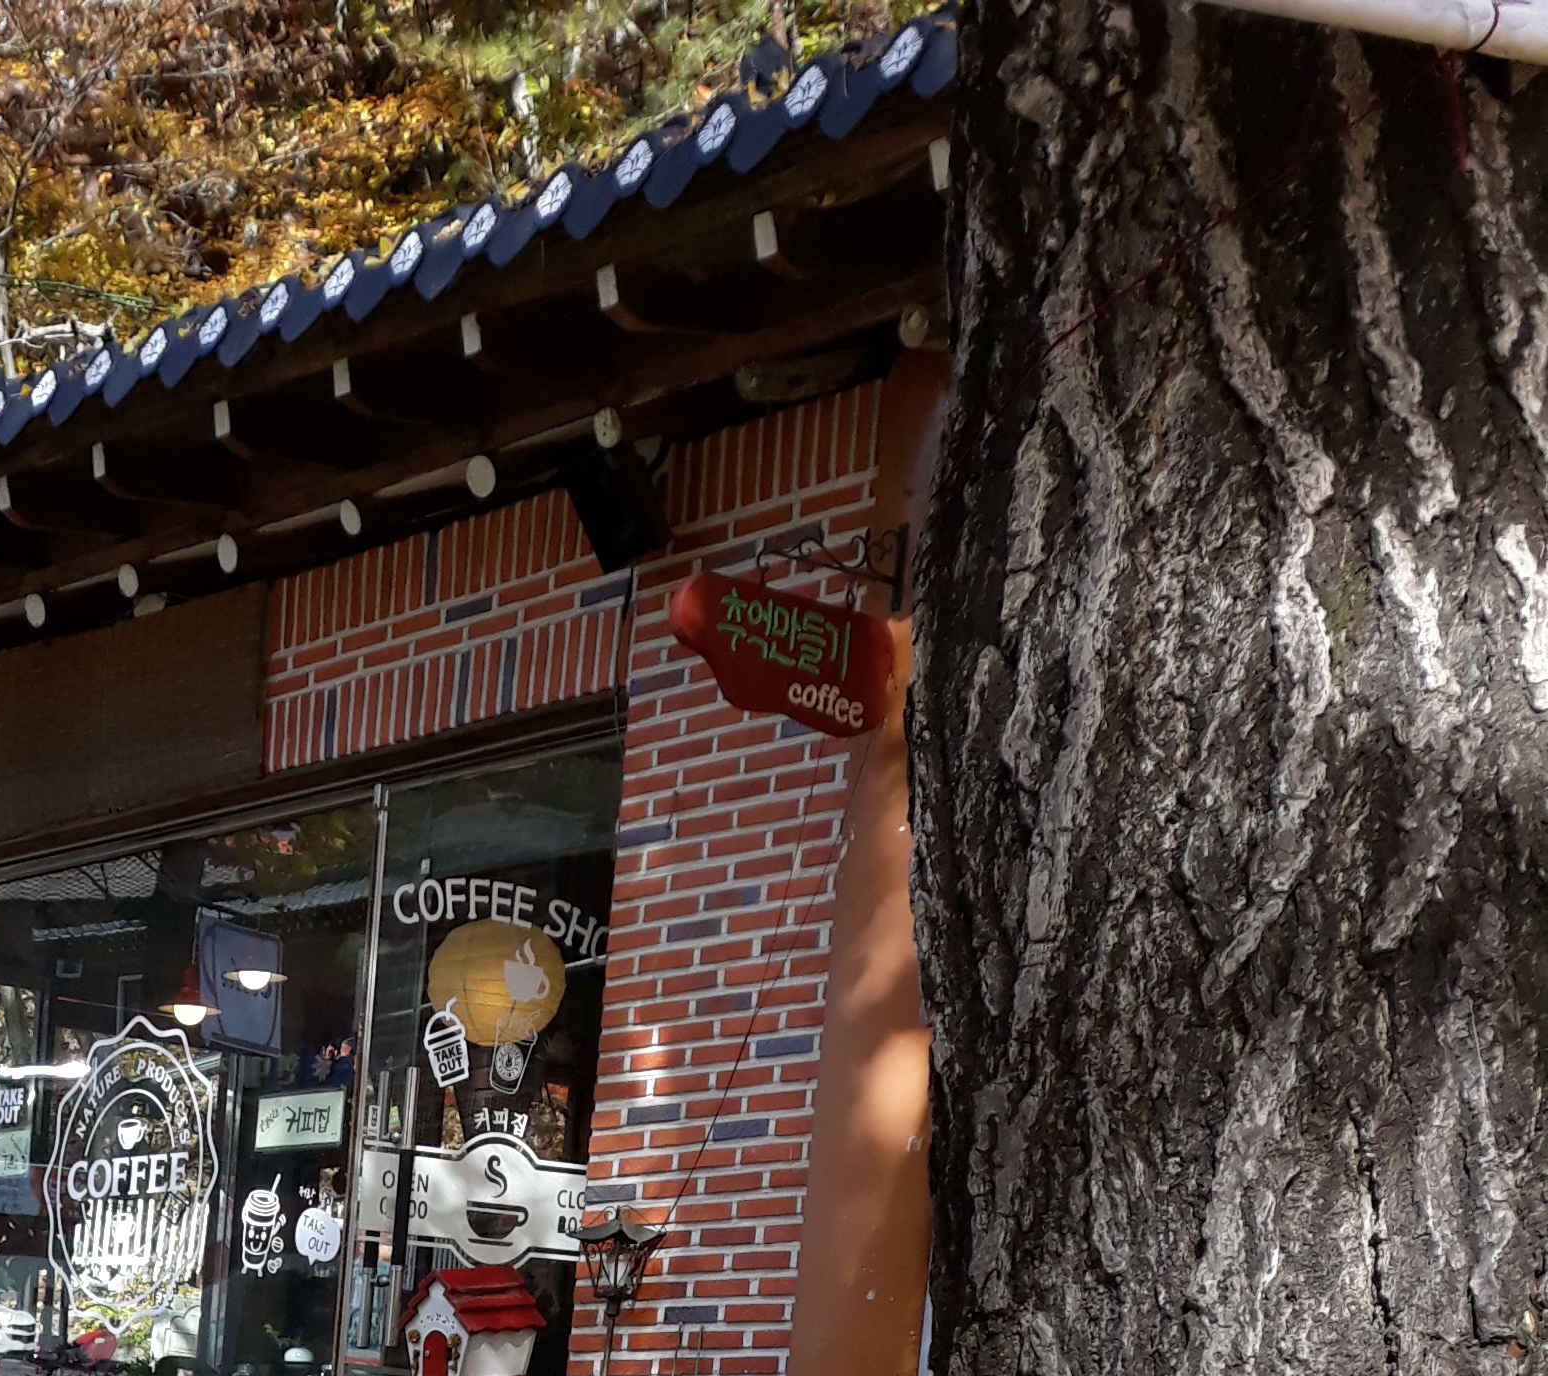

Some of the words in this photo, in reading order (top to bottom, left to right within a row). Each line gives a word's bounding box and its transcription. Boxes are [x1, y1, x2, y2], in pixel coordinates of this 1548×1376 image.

[788, 682, 864, 729] coffee
[393, 877, 537, 930] COFFEE
[543, 899, 610, 965] SHO
[434, 1044, 463, 1063] TAKE
[438, 1056, 462, 1075] OUT
[75, 1064, 122, 1140] NATURE
[136, 1057, 191, 1145] PRODUCTS
[473, 1107, 529, 1138] 커피집
[67, 1151, 190, 1201] COFFEE
[557, 1189, 586, 1210] CLO
[308, 1236, 331, 1255] OUT
